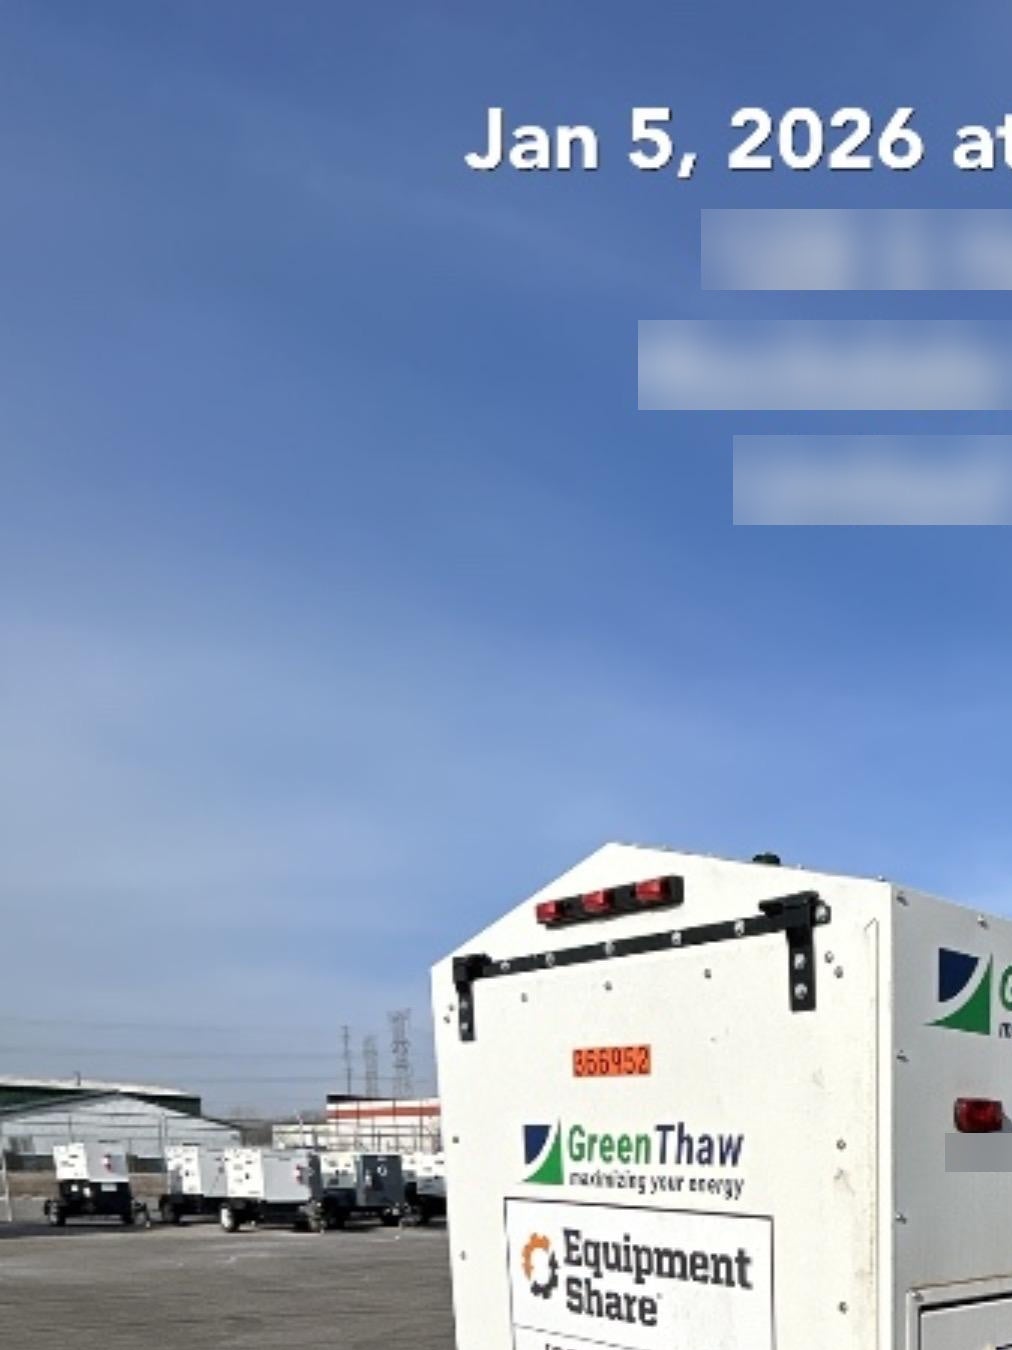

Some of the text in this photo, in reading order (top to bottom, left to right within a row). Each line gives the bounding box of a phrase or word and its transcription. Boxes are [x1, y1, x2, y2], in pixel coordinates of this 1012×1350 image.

[569, 1169, 744, 1201] maximizing your energy
[563, 1227, 753, 1291] Equipment
[565, 1276, 658, 1327] Share
